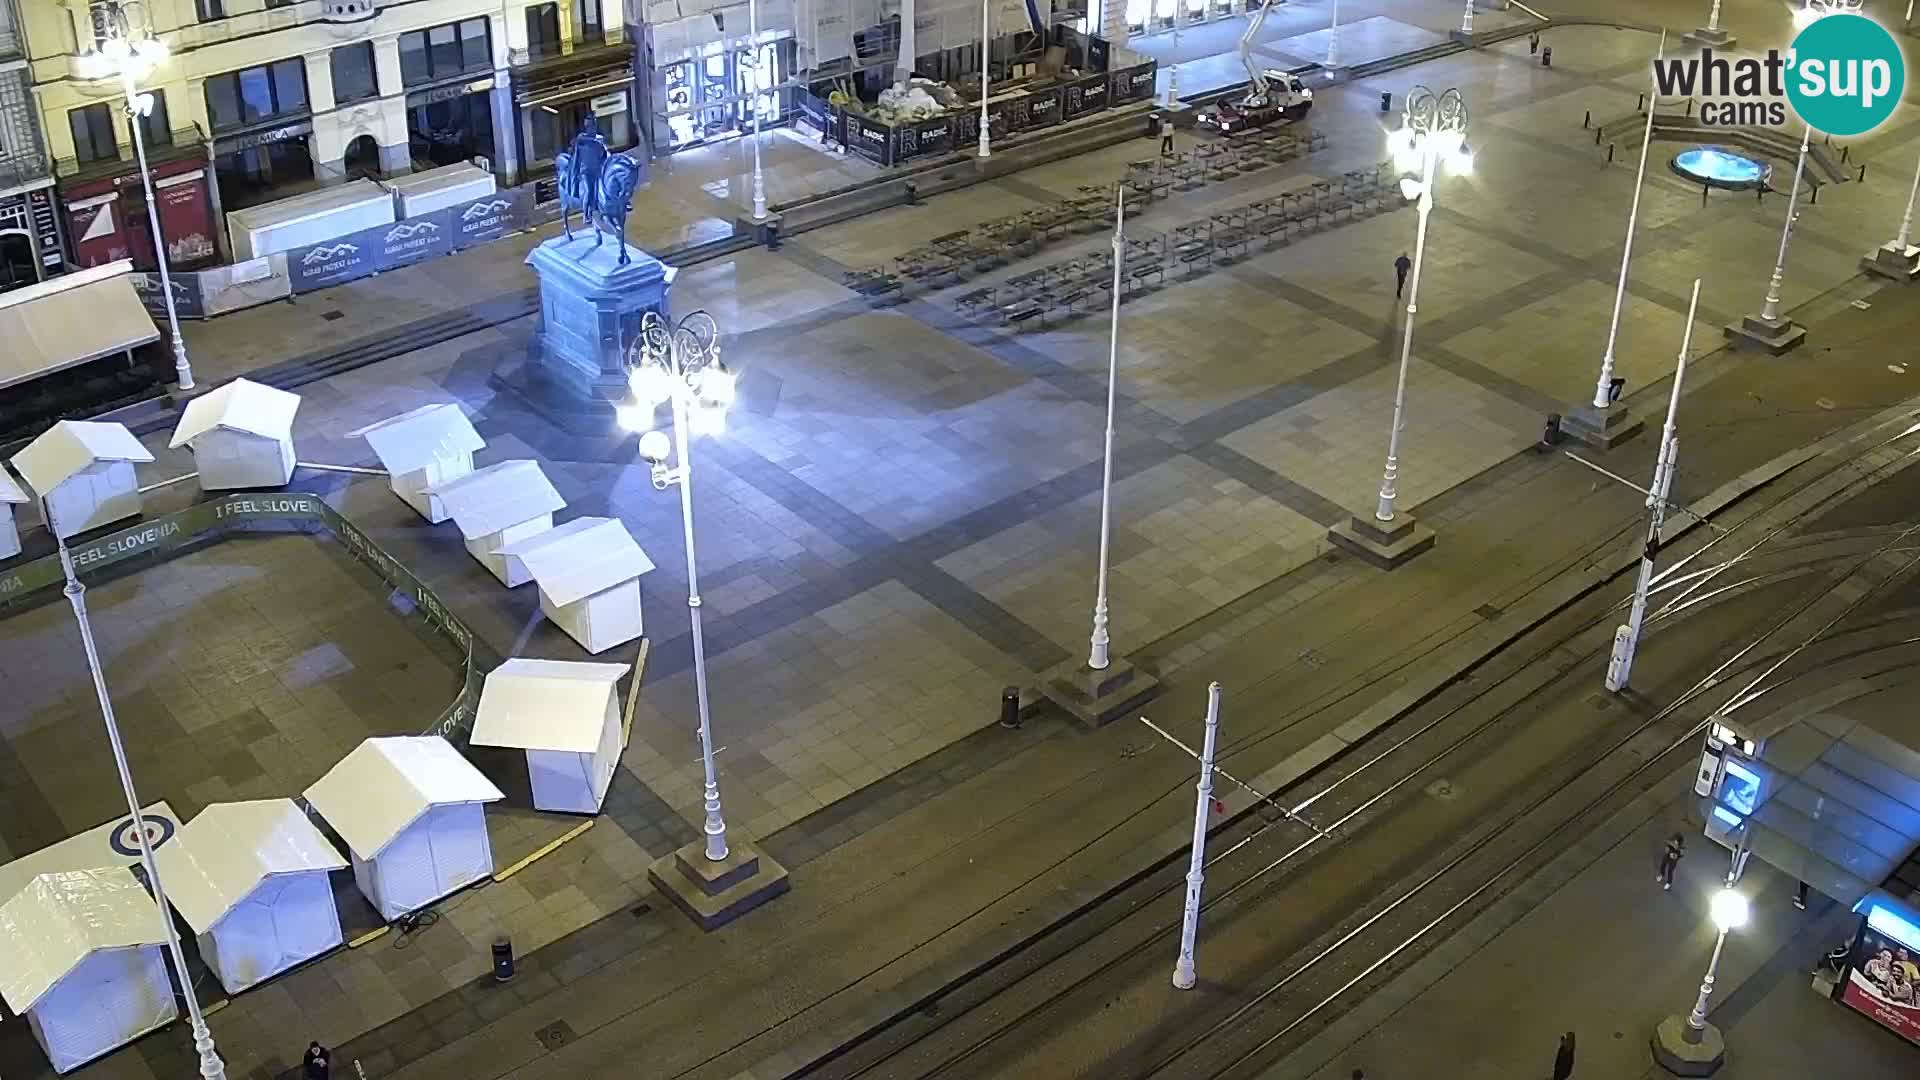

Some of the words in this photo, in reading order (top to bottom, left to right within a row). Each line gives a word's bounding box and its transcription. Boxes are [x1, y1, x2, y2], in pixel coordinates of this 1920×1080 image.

[215, 505, 223, 520] I
[224, 501, 260, 516] FEEL
[71, 547, 107, 569] FEEL
[107, 521, 180, 555] SLOVENIA
